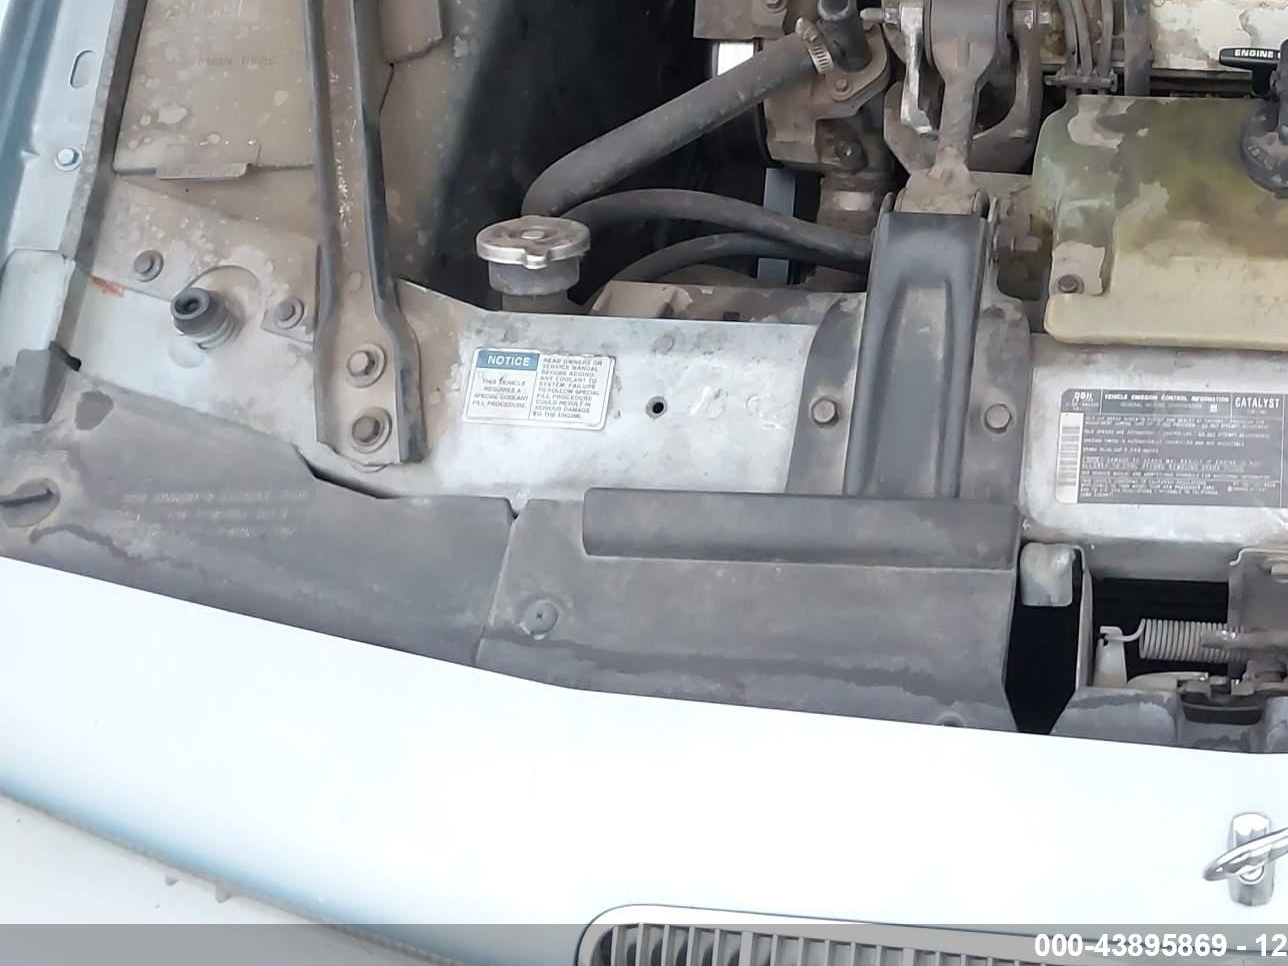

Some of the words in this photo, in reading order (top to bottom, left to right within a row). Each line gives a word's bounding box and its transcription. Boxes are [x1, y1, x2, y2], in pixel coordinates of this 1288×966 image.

[1234, 49, 1274, 58] ENGINE
[487, 355, 531, 366] NOTICE
[499, 378, 526, 386] VEHICLE
[1191, 395, 1229, 403] INFORMATION
[1234, 397, 1281, 409] CATALYST
